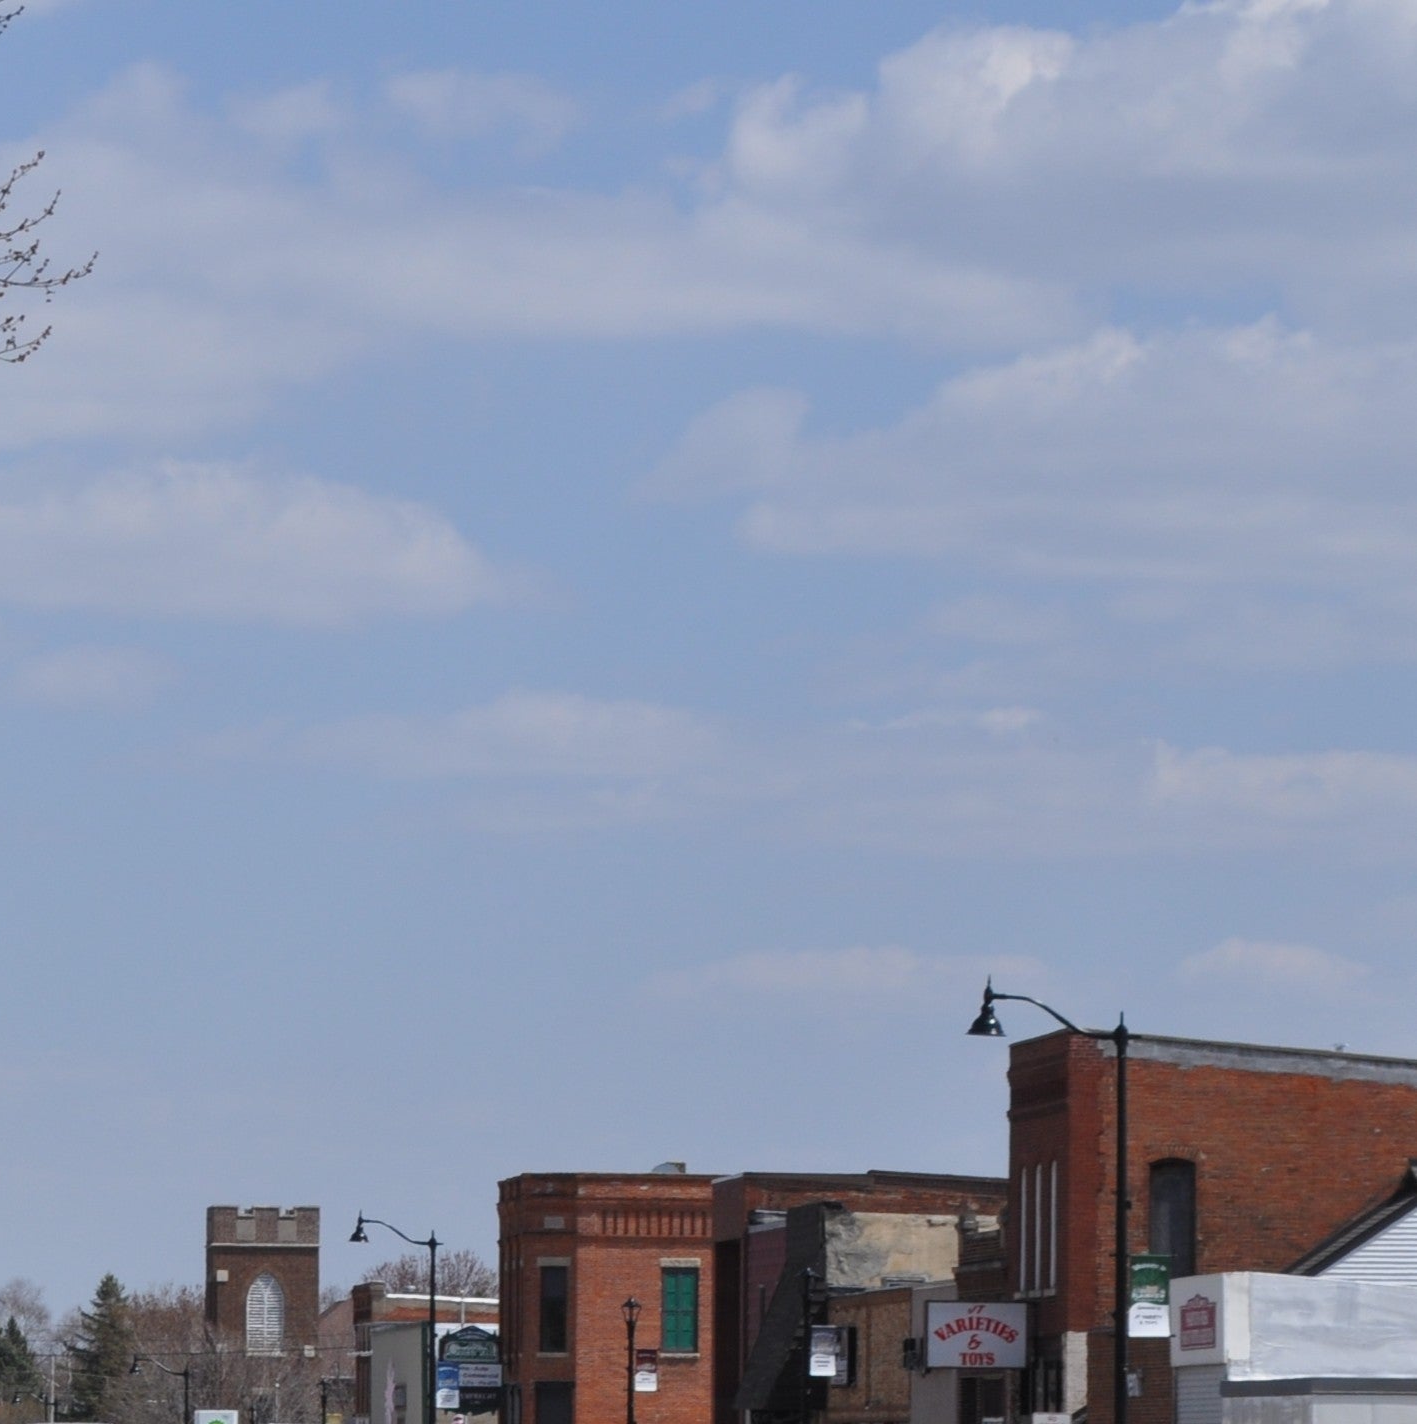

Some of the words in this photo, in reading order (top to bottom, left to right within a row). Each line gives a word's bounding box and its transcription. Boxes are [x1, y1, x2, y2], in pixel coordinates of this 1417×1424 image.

[933, 1316, 1020, 1344] VARIETIES
[967, 1333, 983, 1350] &
[959, 1352, 996, 1366] TOYS
